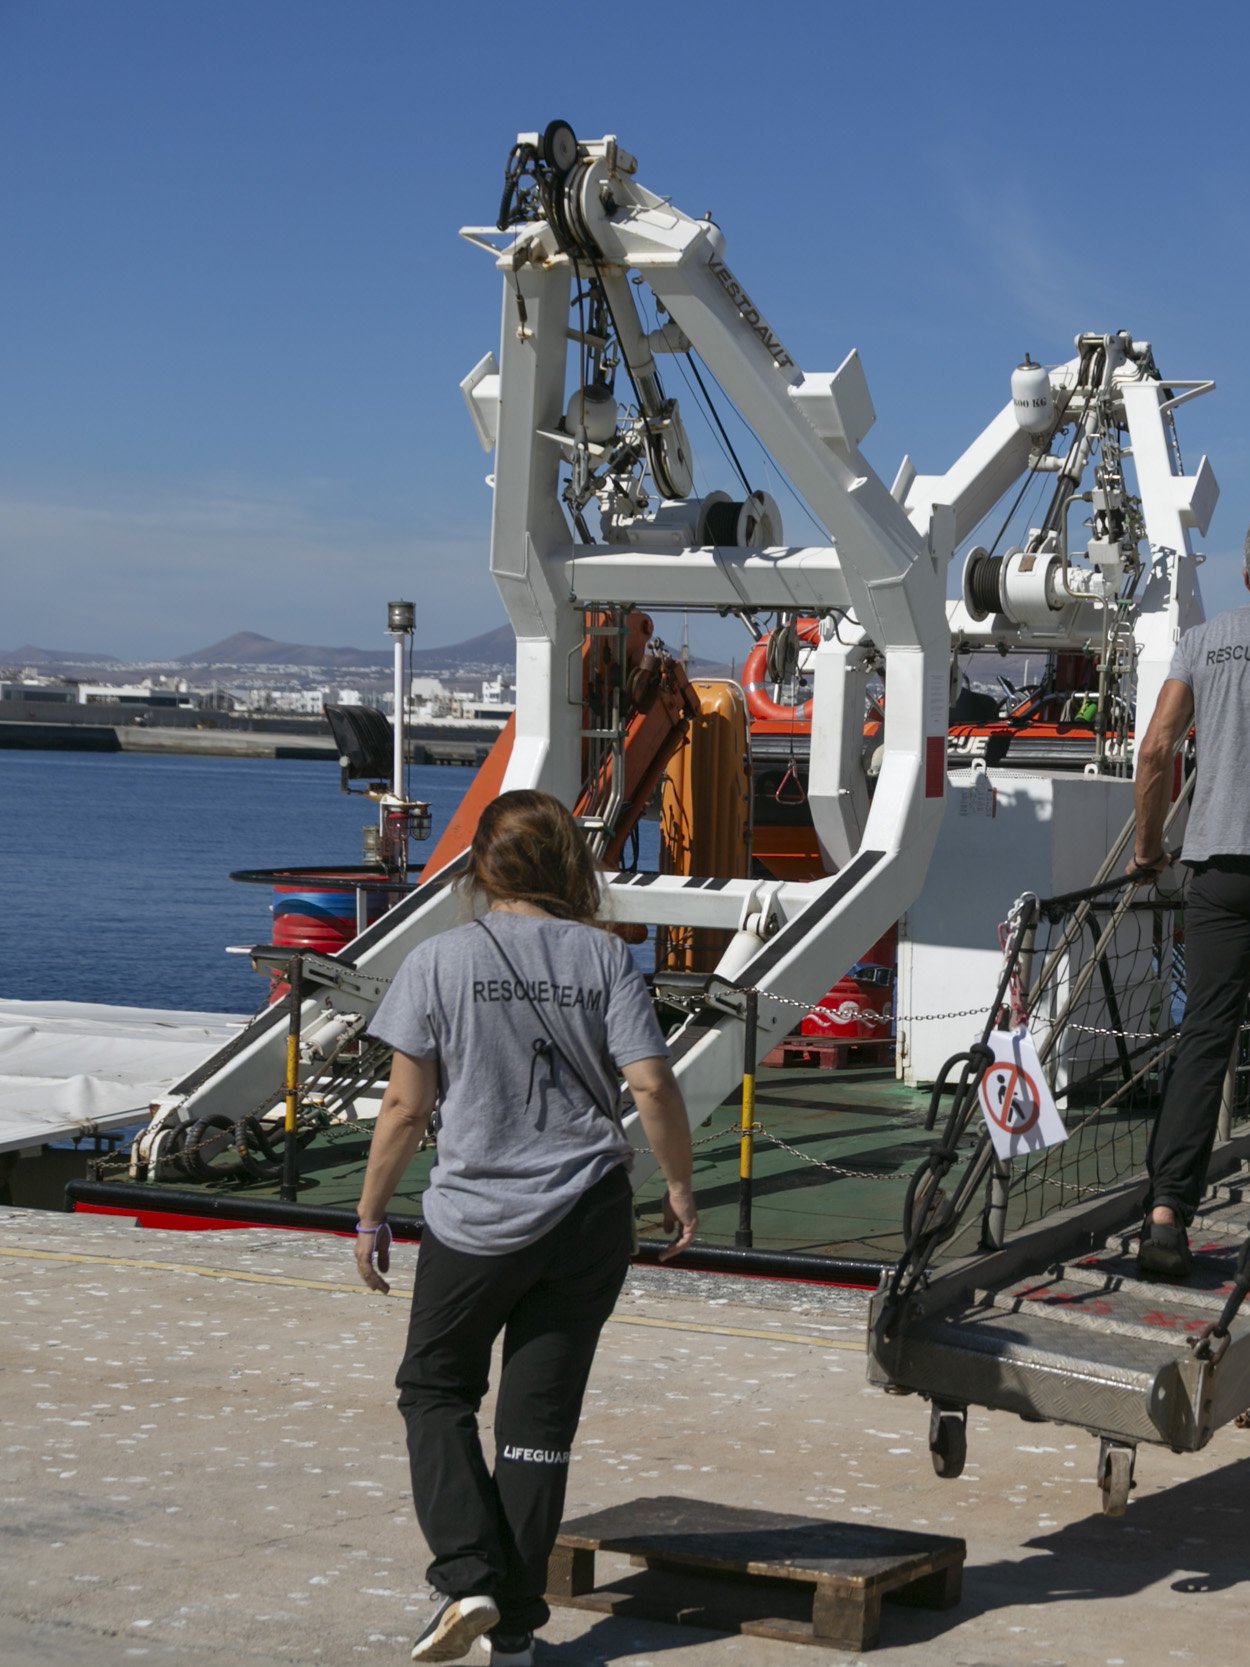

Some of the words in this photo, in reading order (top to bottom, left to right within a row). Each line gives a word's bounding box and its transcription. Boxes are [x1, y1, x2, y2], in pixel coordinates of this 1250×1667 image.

[708, 252, 794, 368] VESTDAVIT
[1032, 397, 1047, 408] KG
[472, 979, 550, 1003] RESCUE
[550, 983, 602, 1012] TEAM
[503, 1444, 570, 1464] LIFEGUAR
